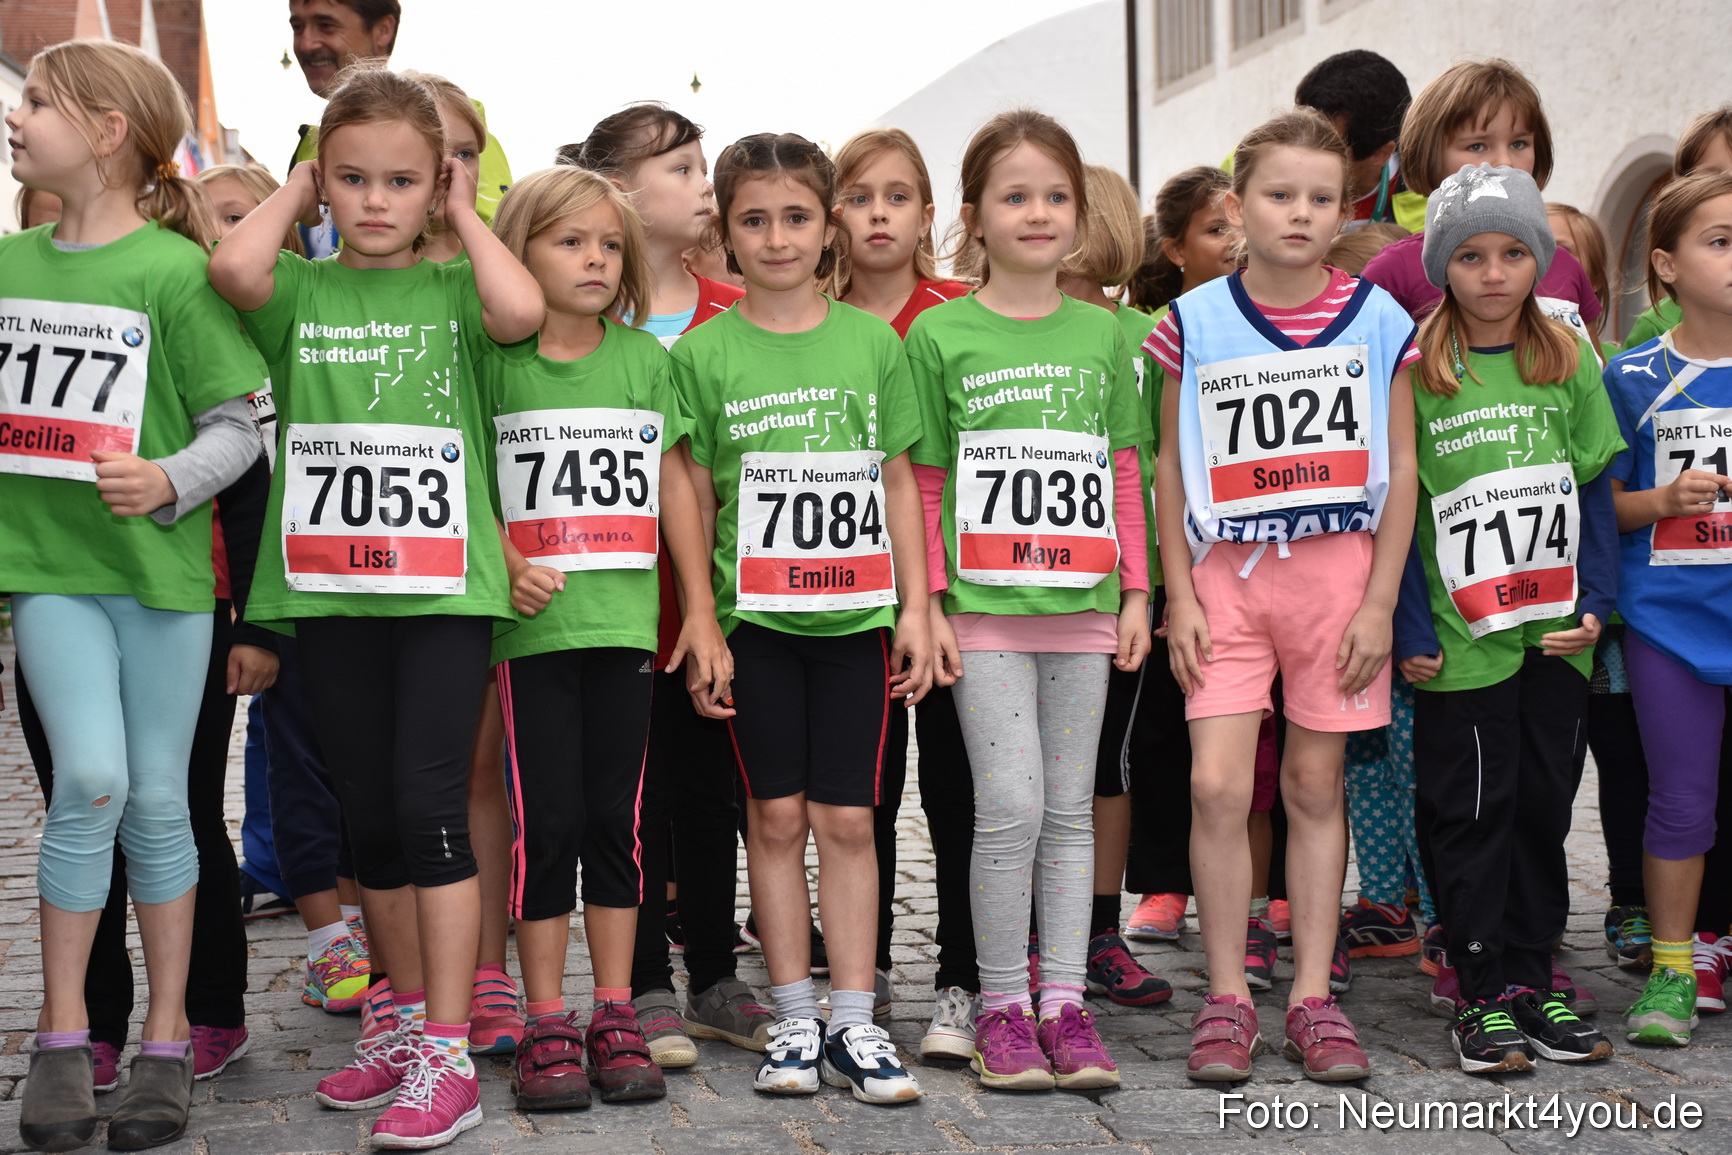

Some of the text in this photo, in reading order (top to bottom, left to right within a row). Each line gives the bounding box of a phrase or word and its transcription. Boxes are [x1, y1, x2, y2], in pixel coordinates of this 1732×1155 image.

[30, 318, 113, 341] Neumarkt
[299, 320, 412, 340] Neumarkter
[299, 344, 389, 365] Stadtlauf
[962, 362, 1072, 392] Neumarkter
[1201, 364, 1340, 395] PARTL Neumarkt
[724, 387, 838, 418] Neumarkter
[966, 384, 1054, 414] Stadtlauf
[729, 408, 817, 441] Stadtlauf
[1216, 386, 1359, 455] 7024
[1428, 403, 1536, 436] Neumarkter
[1657, 425, 1706, 442] PARTL
[0, 422, 76, 453] Cecilia
[291, 441, 345, 456] PARTL
[350, 441, 434, 458] Neumarkt
[500, 427, 555, 445] PARTL
[559, 425, 633, 441] Neumarkt
[1359, 437, 1366, 447] K
[1435, 424, 1518, 457] Stadtlauf
[963, 446, 1017, 461] PARTL
[1021, 445, 1093, 463] Neumarkt
[1212, 455, 1219, 465] 3
[515, 448, 648, 510] 7435
[744, 468, 798, 483] PARTL
[1253, 461, 1331, 491] Sophia
[306, 465, 451, 529] 7053
[975, 468, 1106, 529] 7038
[1439, 482, 1556, 523] PARTL Neumarkt
[290, 522, 296, 532] 3
[453, 525, 459, 535] K
[757, 490, 882, 550] 7084
[963, 521, 969, 531] 3
[524, 521, 634, 553] Johanna
[745, 545, 751, 555] 3
[1449, 503, 1568, 577] 7174
[350, 544, 398, 569] Lisa
[1012, 542, 1071, 570] Maya
[788, 566, 855, 588] Emilia
[1495, 578, 1539, 607] Emilia
